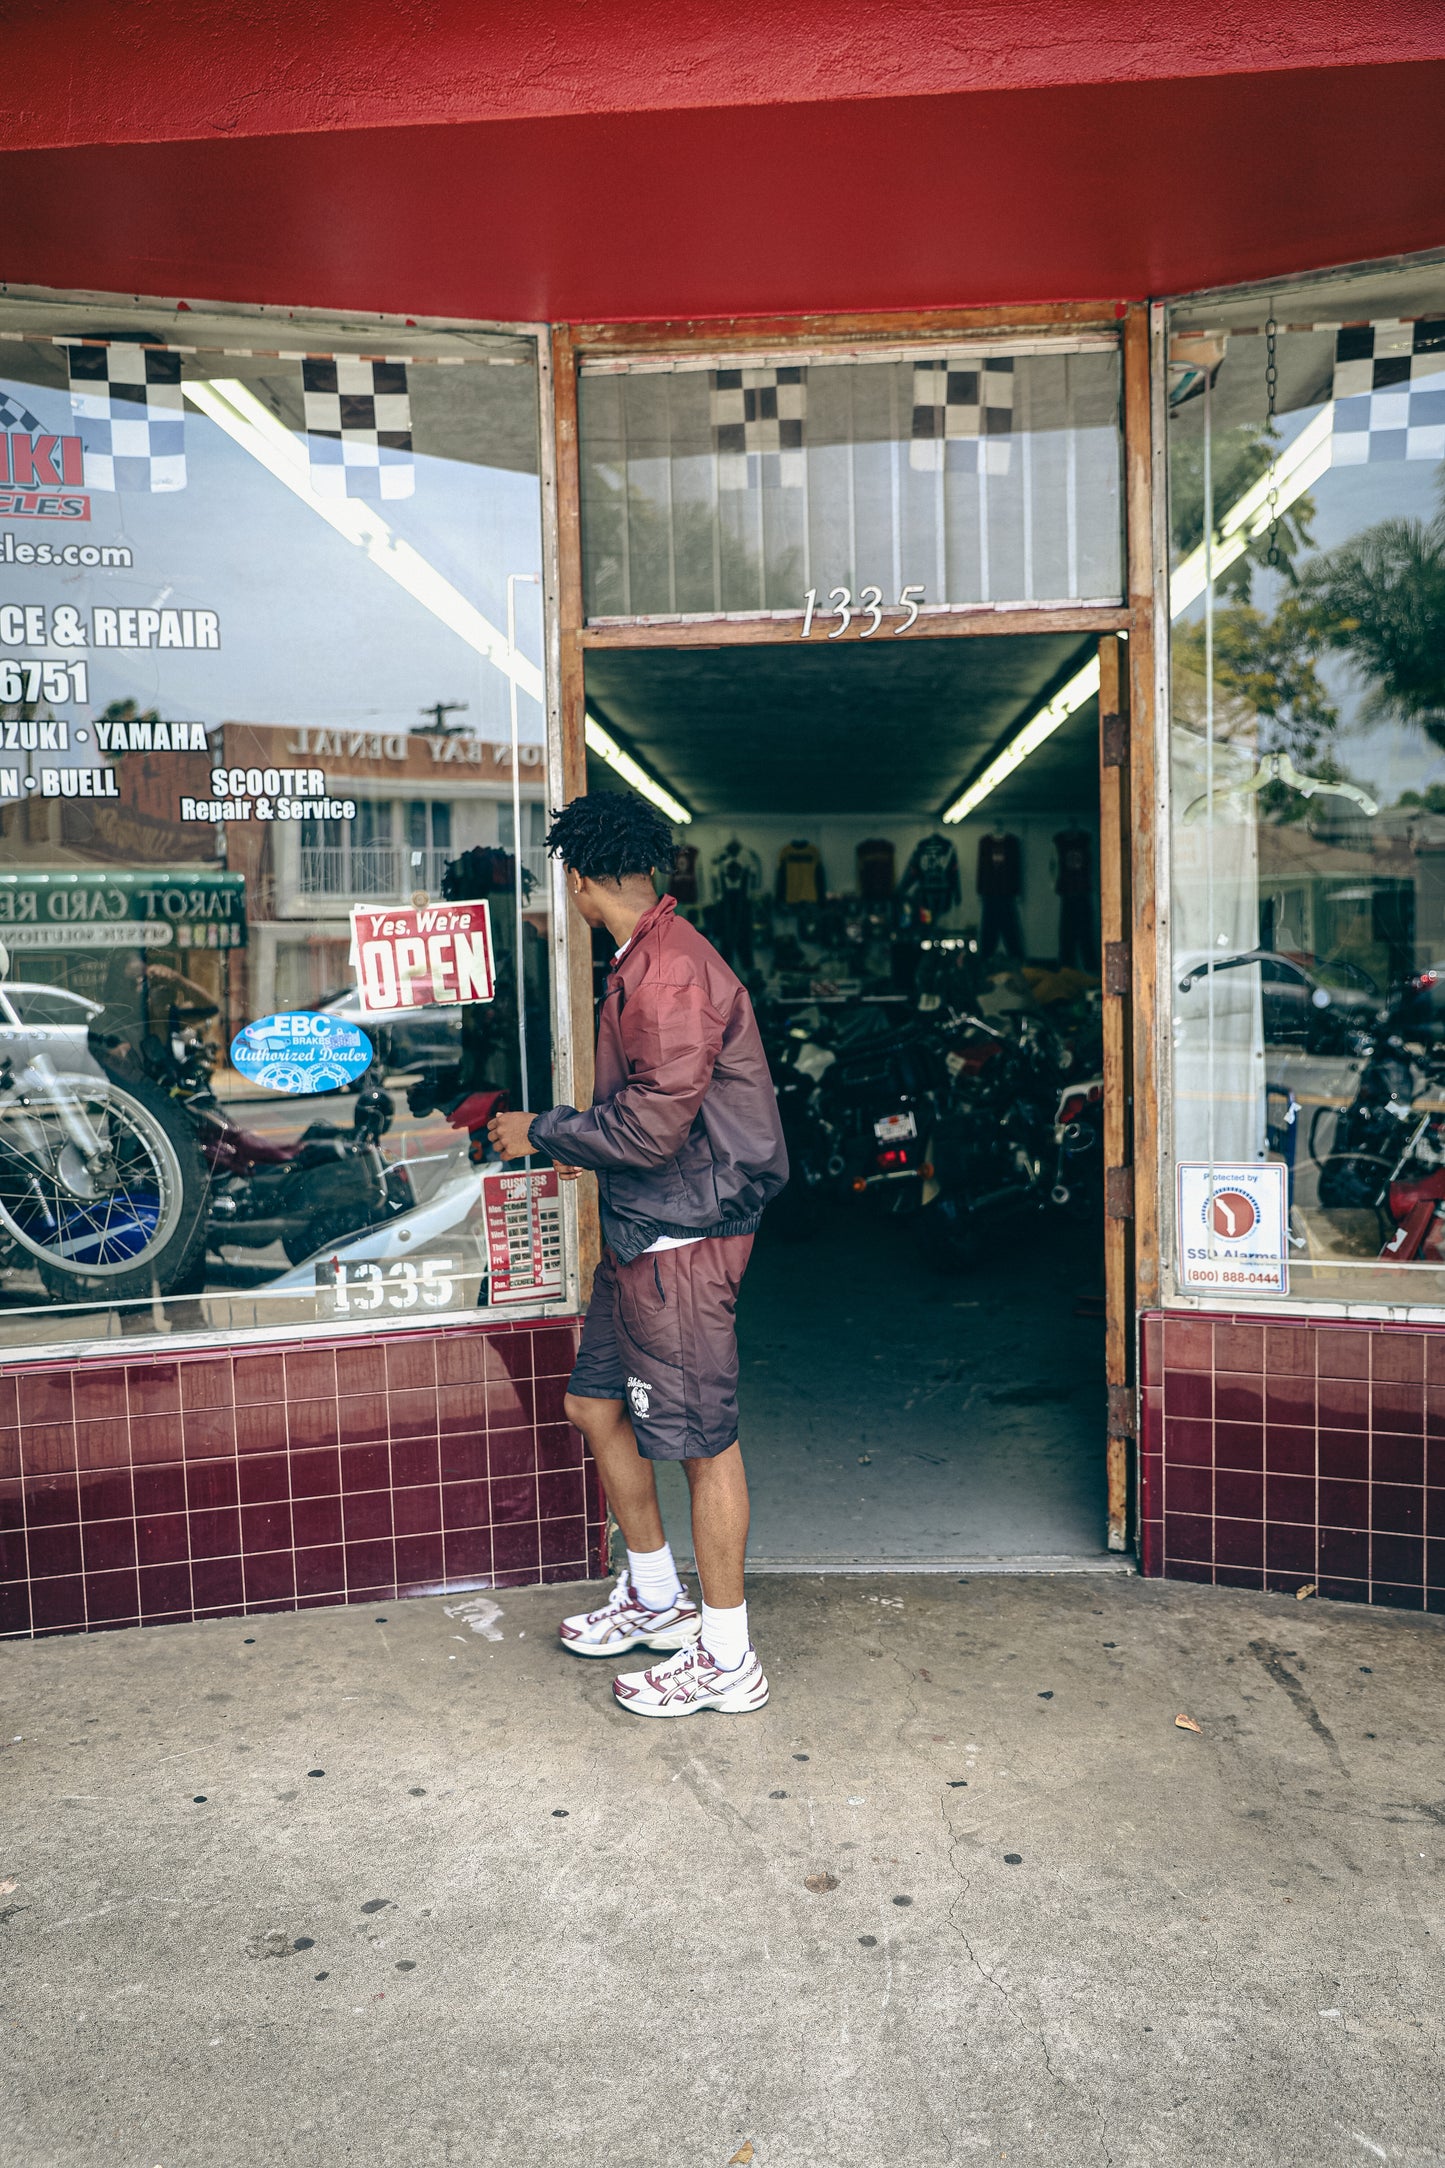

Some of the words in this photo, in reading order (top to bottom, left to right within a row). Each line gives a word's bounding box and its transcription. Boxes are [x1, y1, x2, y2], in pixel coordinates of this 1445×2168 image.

[800, 585, 926, 639] 1335
[52, 604, 89, 648] &
[92, 606, 222, 650] REPAIR
[0, 659, 89, 704] 6751
[0, 720, 70, 752] ZUKI
[93, 721, 210, 752] YAMAHA
[41, 768, 120, 798] BUELL
[210, 768, 326, 798] SCOOTER
[180, 797, 253, 823] Repair
[255, 798, 275, 822] &
[276, 797, 357, 822] Service
[370, 914, 411, 937] Yes,
[415, 911, 472, 933] We're
[362, 931, 489, 1009] OPEN
[272, 1015, 331, 1037] EBC
[234, 1047, 316, 1062] Authorized
[318, 1047, 368, 1062] Dealer
[292, 1036, 331, 1046] BRAKES
[1203, 1173, 1245, 1182] Potected
[1247, 1174, 1259, 1183] by
[503, 1201, 528, 1212] CLOSE
[333, 1259, 453, 1312] 1335
[1187, 1269, 1219, 1282] (800)
[1222, 1271, 1280, 1285] 888-0444
